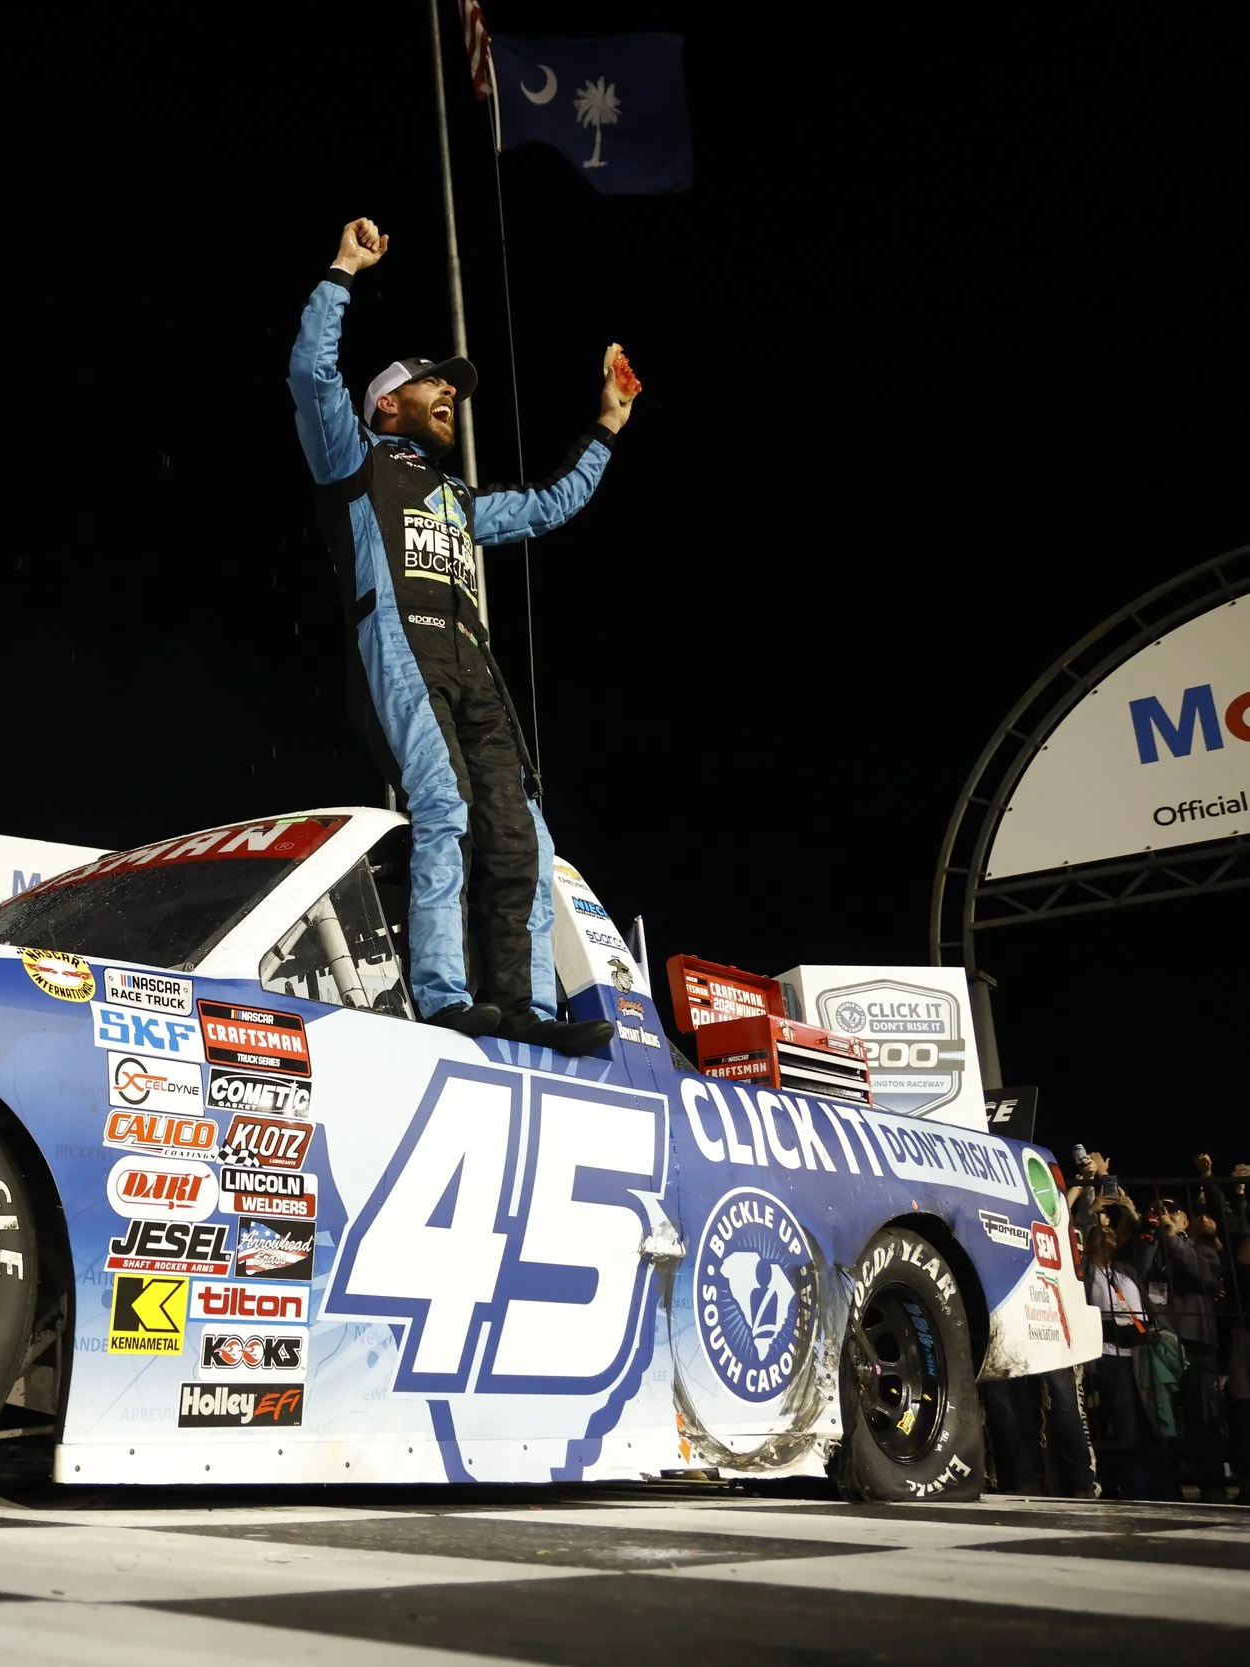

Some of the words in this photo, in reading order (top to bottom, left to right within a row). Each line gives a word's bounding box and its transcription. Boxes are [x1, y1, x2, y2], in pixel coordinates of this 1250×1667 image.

[405, 552, 468, 585] BUCKLE
[408, 614, 446, 628] sparco
[1153, 790, 1248, 826] Official
[26, 949, 80, 968] NASCAR
[32, 972, 94, 1000] INTERNATIONAL
[131, 975, 181, 996] NASCAR
[709, 982, 763, 1007] CRAFTSMAN
[111, 987, 142, 1003] RACE
[145, 994, 185, 1010] TRUCK
[713, 997, 736, 1014] 2024
[241, 1009, 274, 1025] NASCAR
[867, 1003, 921, 1019] CLICK
[926, 1003, 942, 1018] IT
[100, 1009, 196, 1053] SKF
[207, 1023, 302, 1053] CRAFTSMAN
[873, 1022, 904, 1031] DON'T
[907, 1022, 929, 1031] RISK
[931, 1022, 940, 1031] IT
[706, 1062, 768, 1079] CRAFTSMAN
[728, 1054, 750, 1063] NASCAR
[210, 1078, 310, 1112] COMETIC
[906, 1080, 945, 1088] RACEWAY
[106, 1111, 216, 1149] CALICO
[681, 1078, 837, 1173] CLICK
[817, 1102, 884, 1177] IT
[230, 1122, 306, 1159] KLOTZ
[164, 1149, 216, 1160] COATINGS
[878, 1123, 956, 1170] DON'T
[946, 1138, 1000, 1185] RISK
[990, 1148, 1017, 1188] IT
[122, 1171, 211, 1202] DART
[225, 1170, 301, 1196] LINCOLN
[241, 1196, 308, 1216] WELDERS
[340, 1075, 657, 1378] 45
[709, 1200, 775, 1259] BUCKLE
[778, 1217, 802, 1256] UP
[111, 1220, 228, 1263] JESEL
[237, 1229, 313, 1253] Arrowhead
[122, 1259, 150, 1270] SHAFT
[154, 1261, 187, 1272] ROCKER
[190, 1262, 215, 1273] ARMS
[254, 1250, 288, 1266] Brass
[198, 1286, 302, 1317] tilton
[1029, 1285, 1050, 1304] Florida
[1024, 1304, 1060, 1323] Watermelon
[111, 1336, 180, 1351] KENNAMETAL
[703, 1284, 743, 1385] SOUTH
[1027, 1323, 1060, 1342] Association
[203, 1334, 302, 1370] KOOKS
[181, 1386, 255, 1424] Holley
[254, 1389, 302, 1420] EFI
